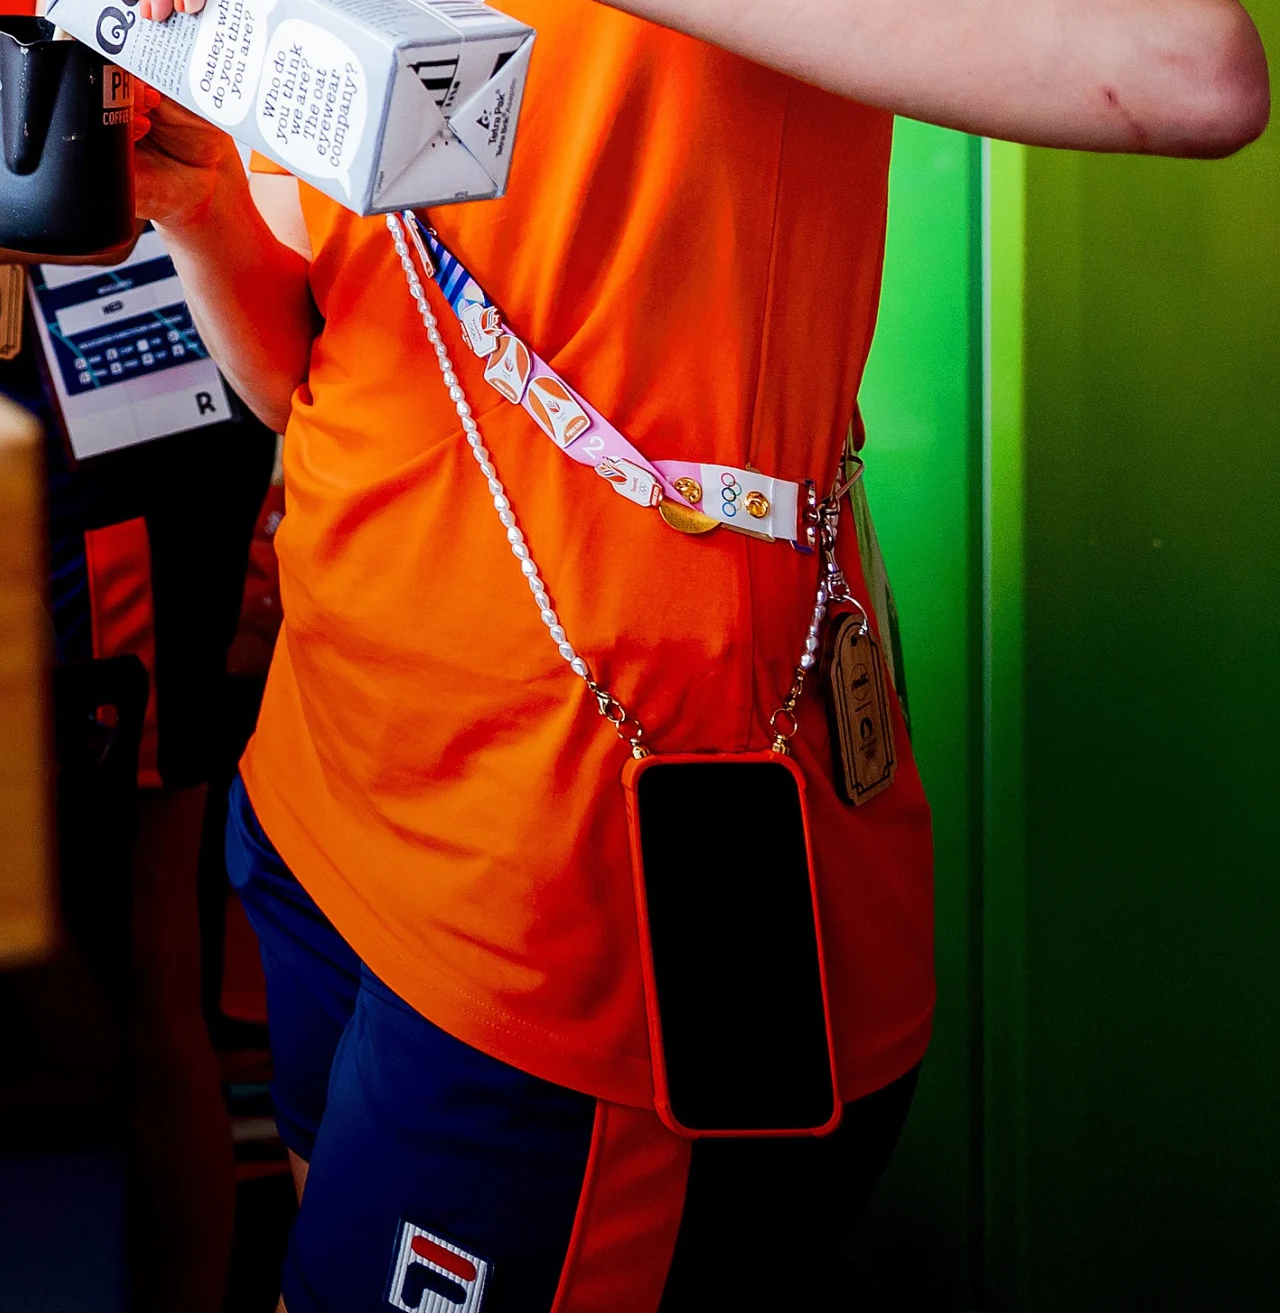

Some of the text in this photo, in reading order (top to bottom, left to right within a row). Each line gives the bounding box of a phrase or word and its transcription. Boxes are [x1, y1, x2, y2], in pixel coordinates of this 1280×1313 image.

[200, 32, 225, 92] Oatley,
[212, 86, 225, 109] do
[220, 48, 235, 86] you
[231, 10, 255, 99] you are?
[263, 51, 285, 118] Who do
[276, 44, 302, 145] you think
[291, 58, 312, 134] we are?
[303, 69, 327, 140] The oat
[317, 69, 340, 156] eyewear
[330, 62, 358, 167] company?
[488, 117, 501, 145] Tetra
[195, 391, 217, 417] R
